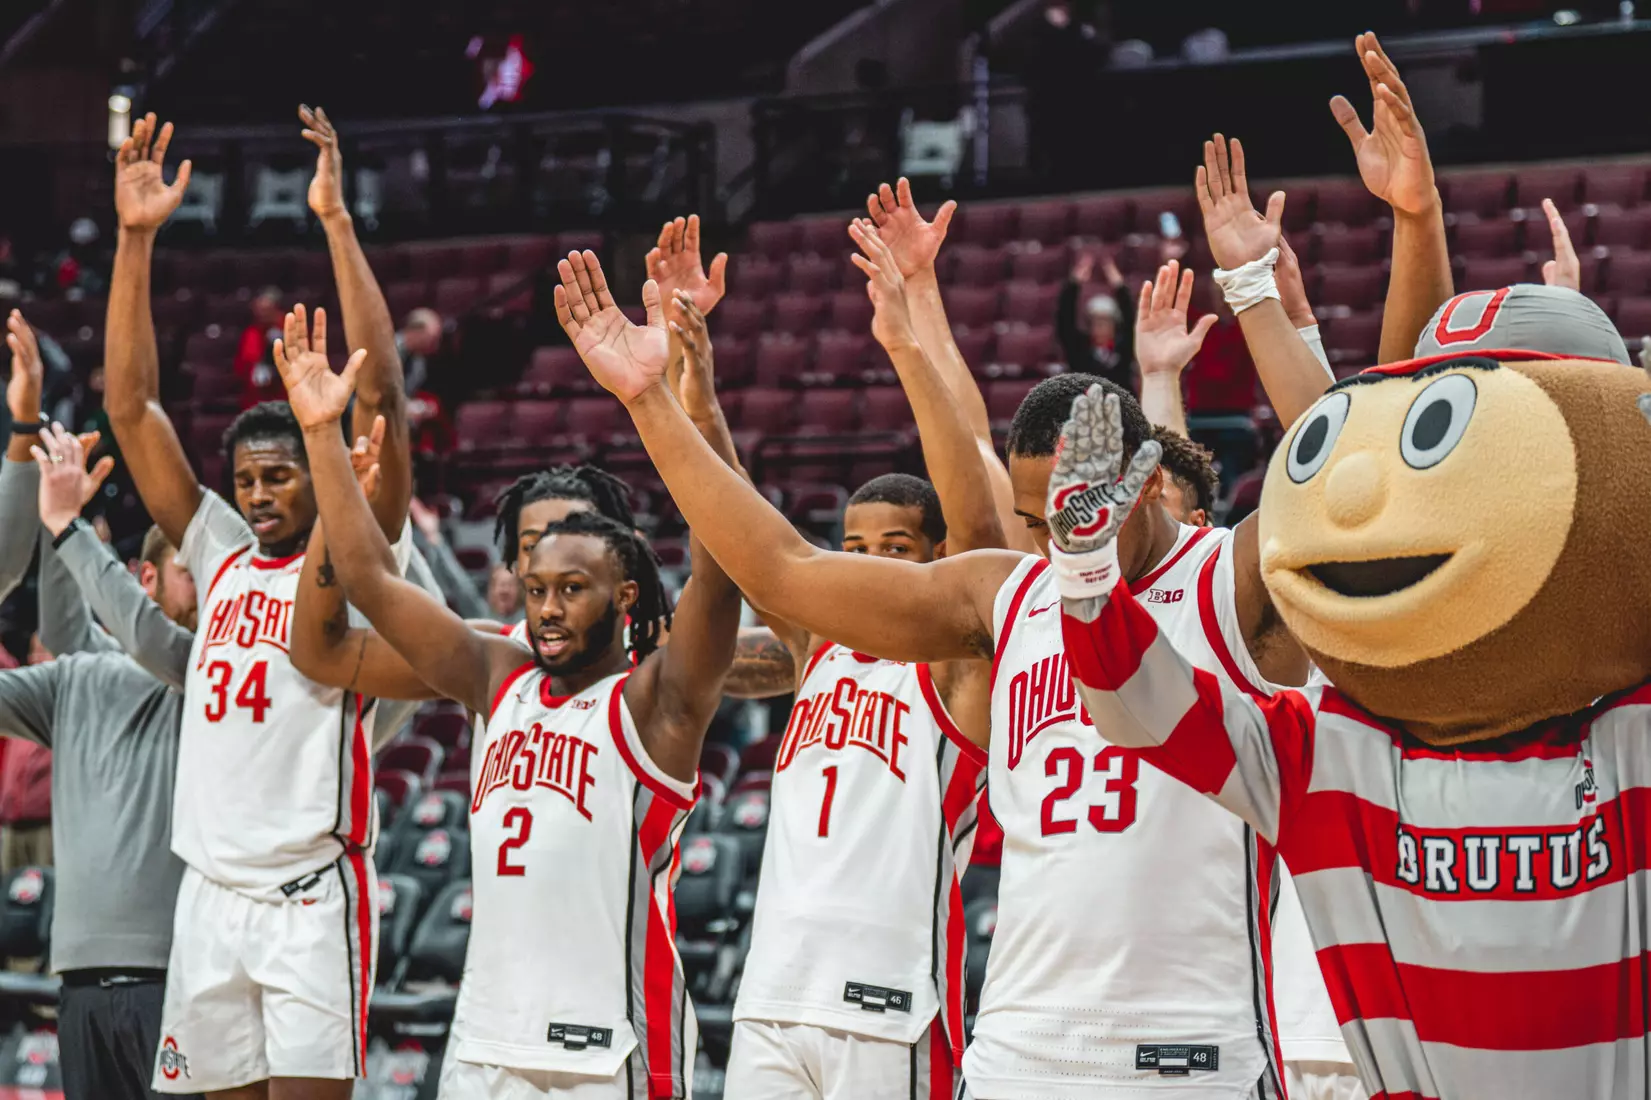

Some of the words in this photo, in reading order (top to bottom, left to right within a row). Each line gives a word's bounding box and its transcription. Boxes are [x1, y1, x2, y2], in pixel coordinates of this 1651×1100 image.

[205, 660, 271, 722] 34
[825, 677, 910, 783] STATE
[817, 765, 838, 838] 1
[1041, 746, 1140, 837] 23
[496, 806, 533, 876] 2
[1395, 814, 1612, 893] BRUTUS
[1193, 1052, 1207, 1063] 48
